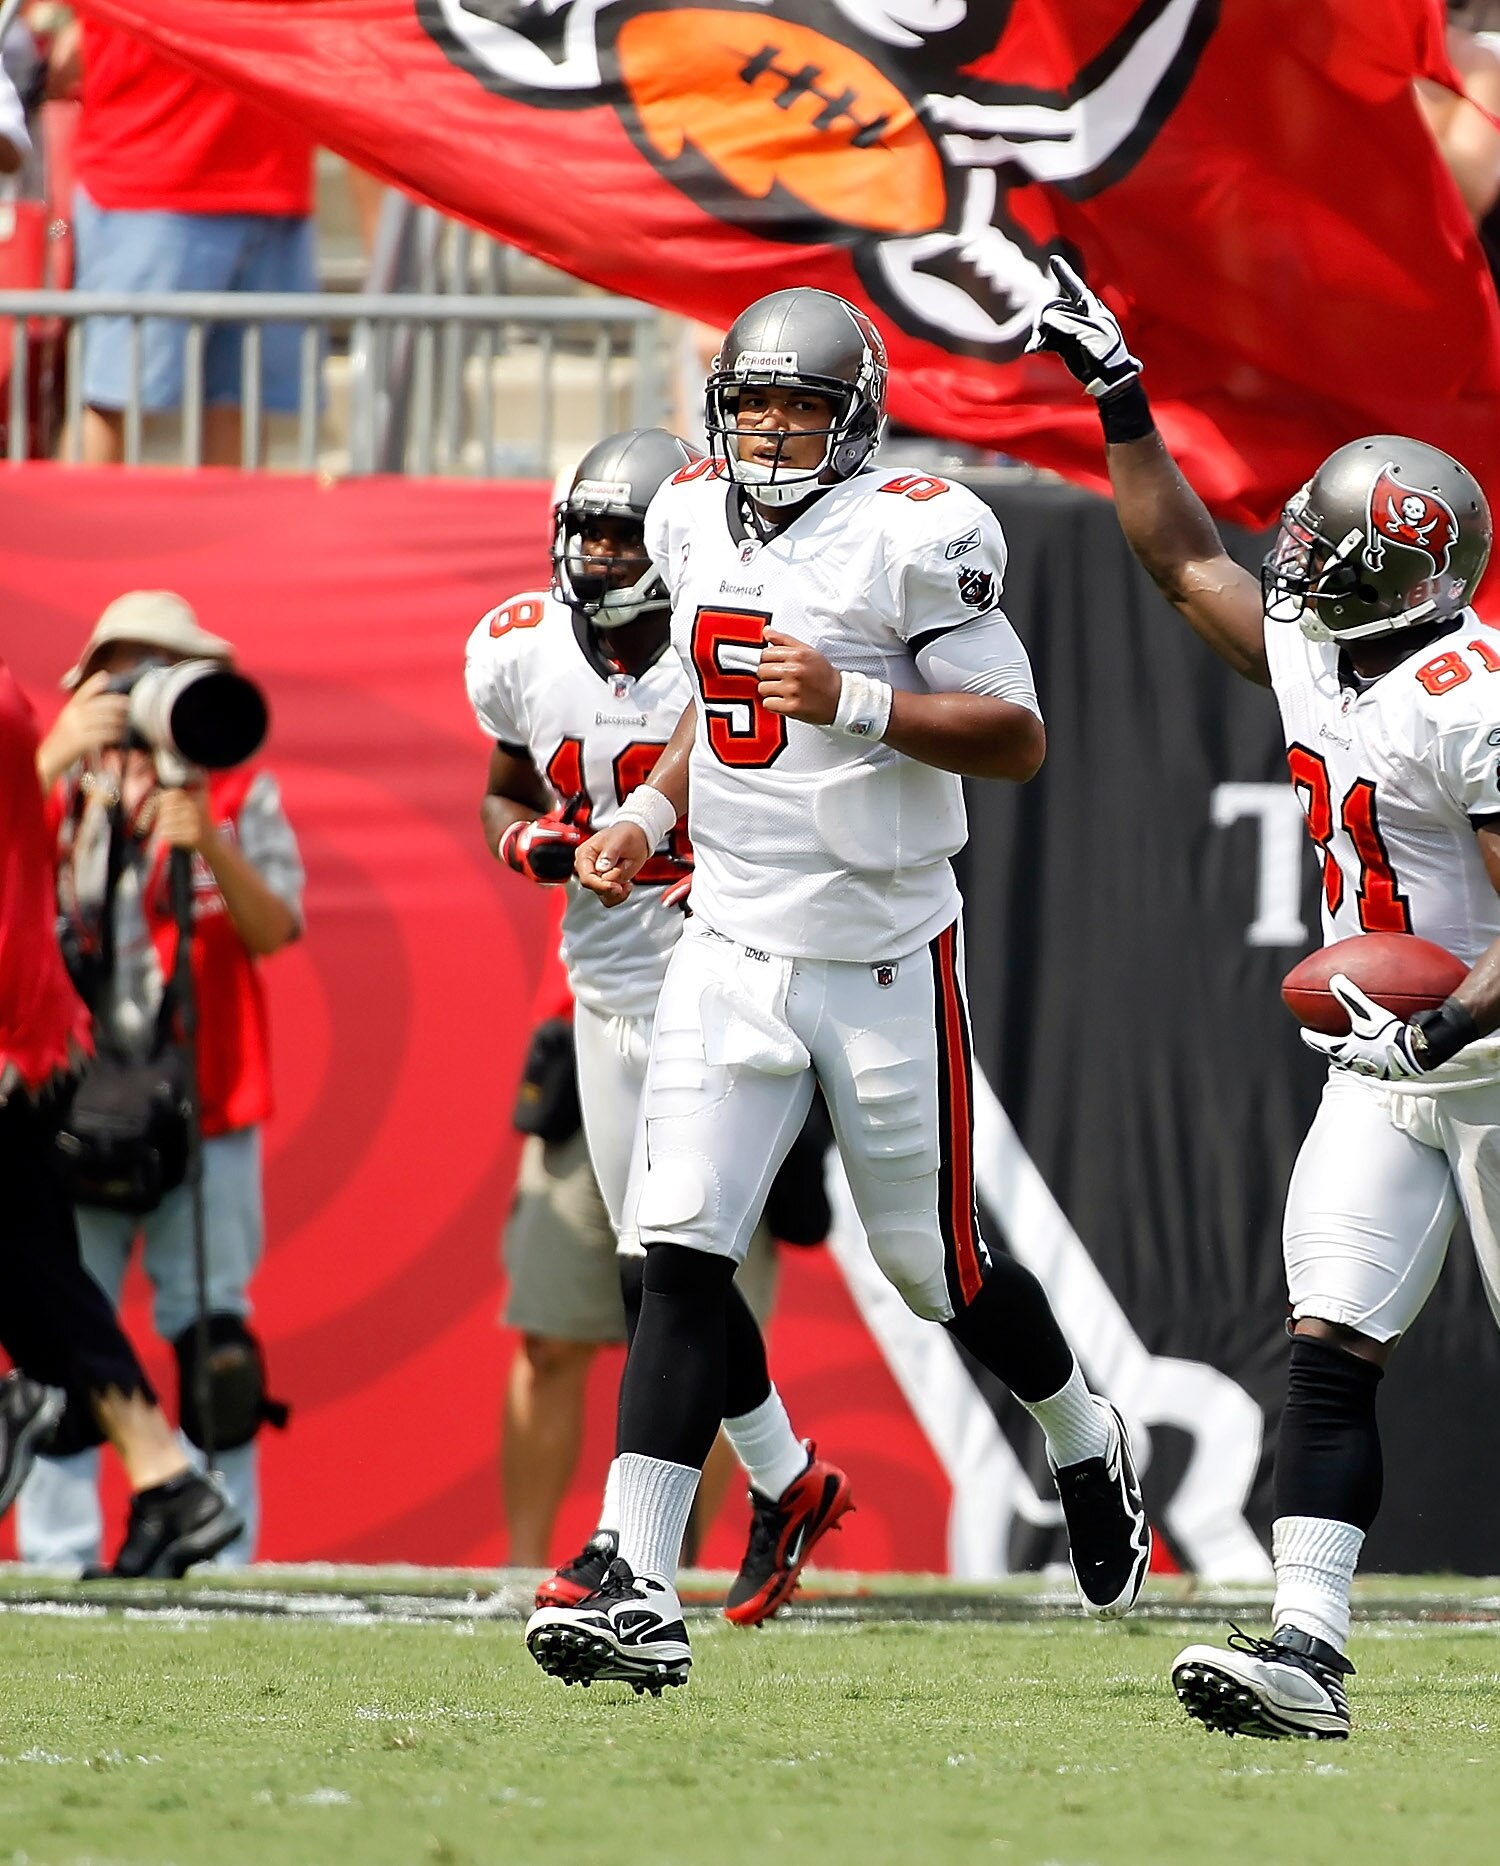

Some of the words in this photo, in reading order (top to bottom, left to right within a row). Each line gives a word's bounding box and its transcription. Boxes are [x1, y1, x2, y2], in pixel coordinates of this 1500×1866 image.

[876, 473, 951, 502] 5
[690, 605, 789, 770] 5
[1286, 741, 1414, 937] 81
